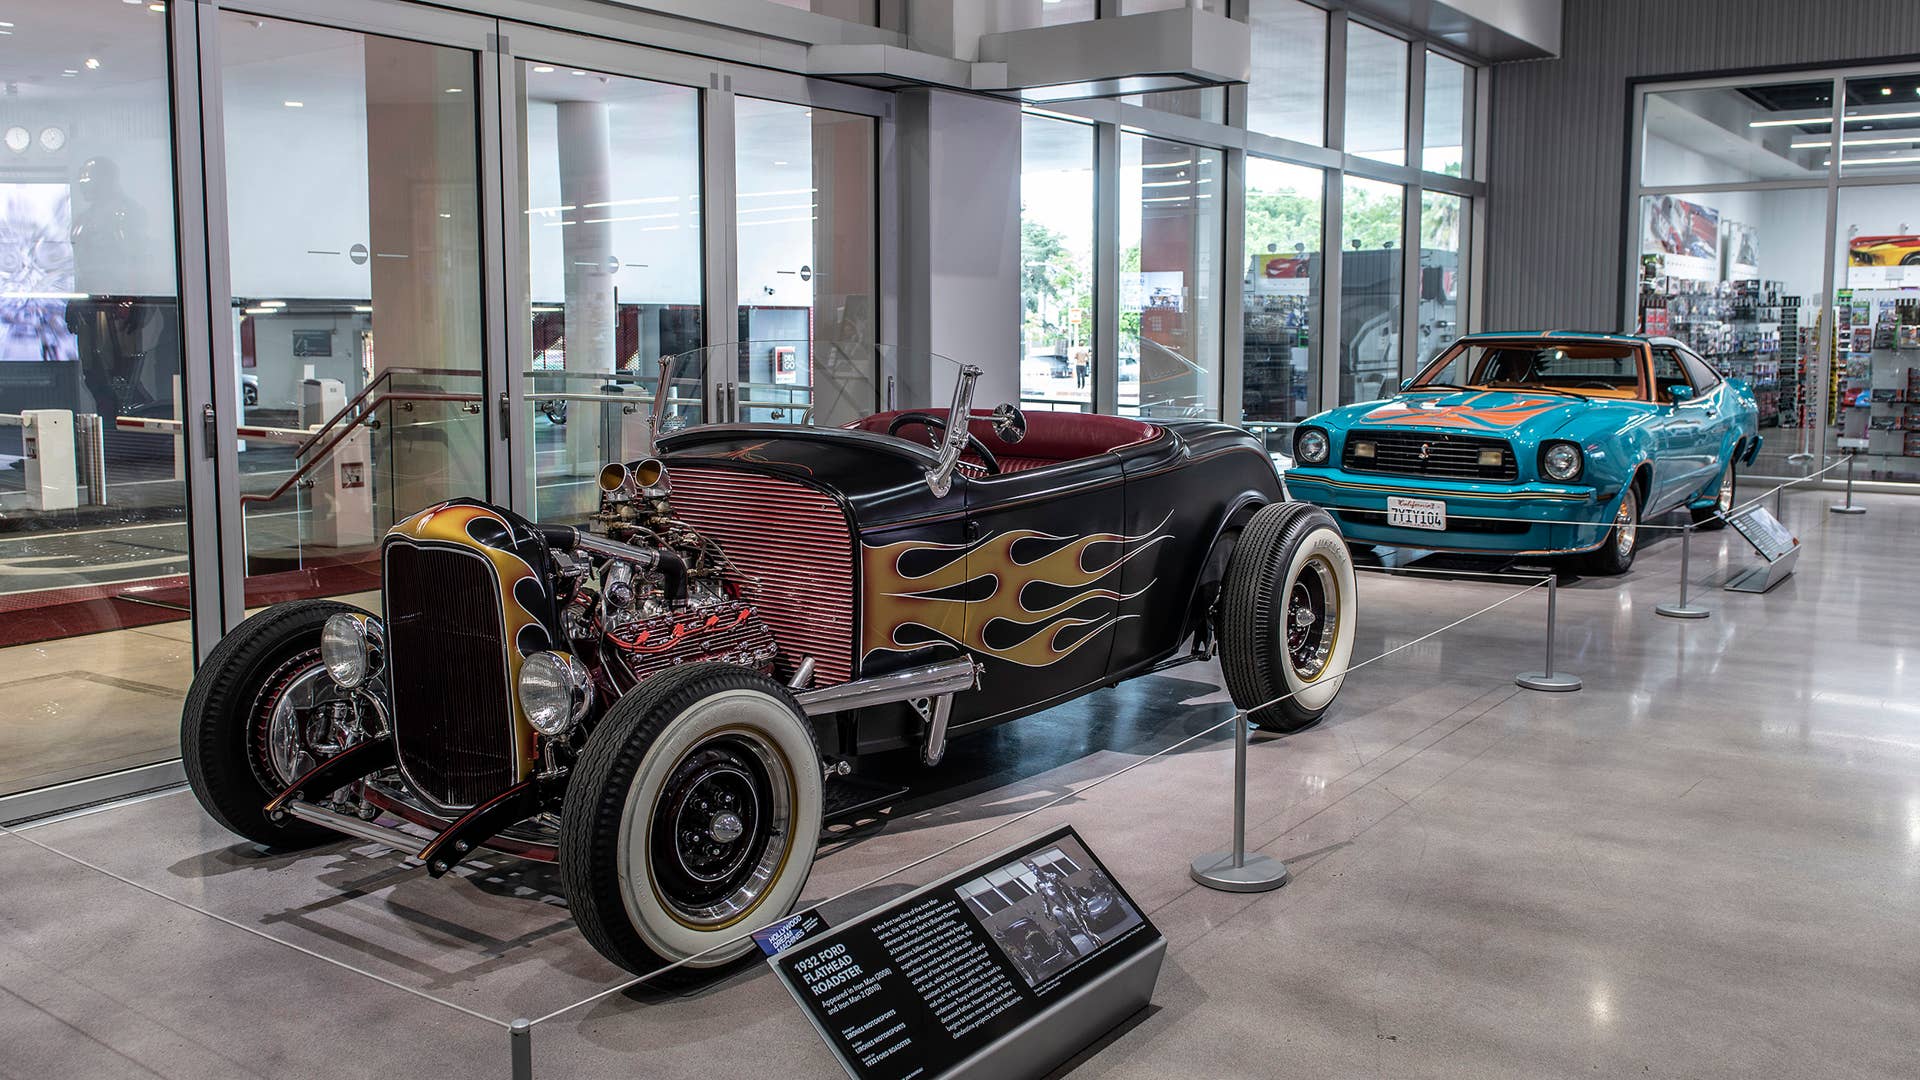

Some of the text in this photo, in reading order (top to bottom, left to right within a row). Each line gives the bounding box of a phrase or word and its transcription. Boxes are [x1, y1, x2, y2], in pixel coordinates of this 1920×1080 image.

[768, 915, 802, 944] HOLLYWOOD
[773, 930, 794, 948] DREAM
[777, 929, 805, 953] MACHINES
[794, 944, 846, 974] 1932 FORD
[803, 954, 853, 984] FLATHEAD
[811, 965, 863, 996] ROADSTER
[822, 989, 848, 1008] Appeared
[853, 982, 864, 992] Iron
[863, 974, 876, 985] Man
[828, 1006, 839, 1015] and
[838, 1000, 850, 1011] Iron
[849, 994, 861, 1005] Man
[865, 983, 882, 996] (2010)
